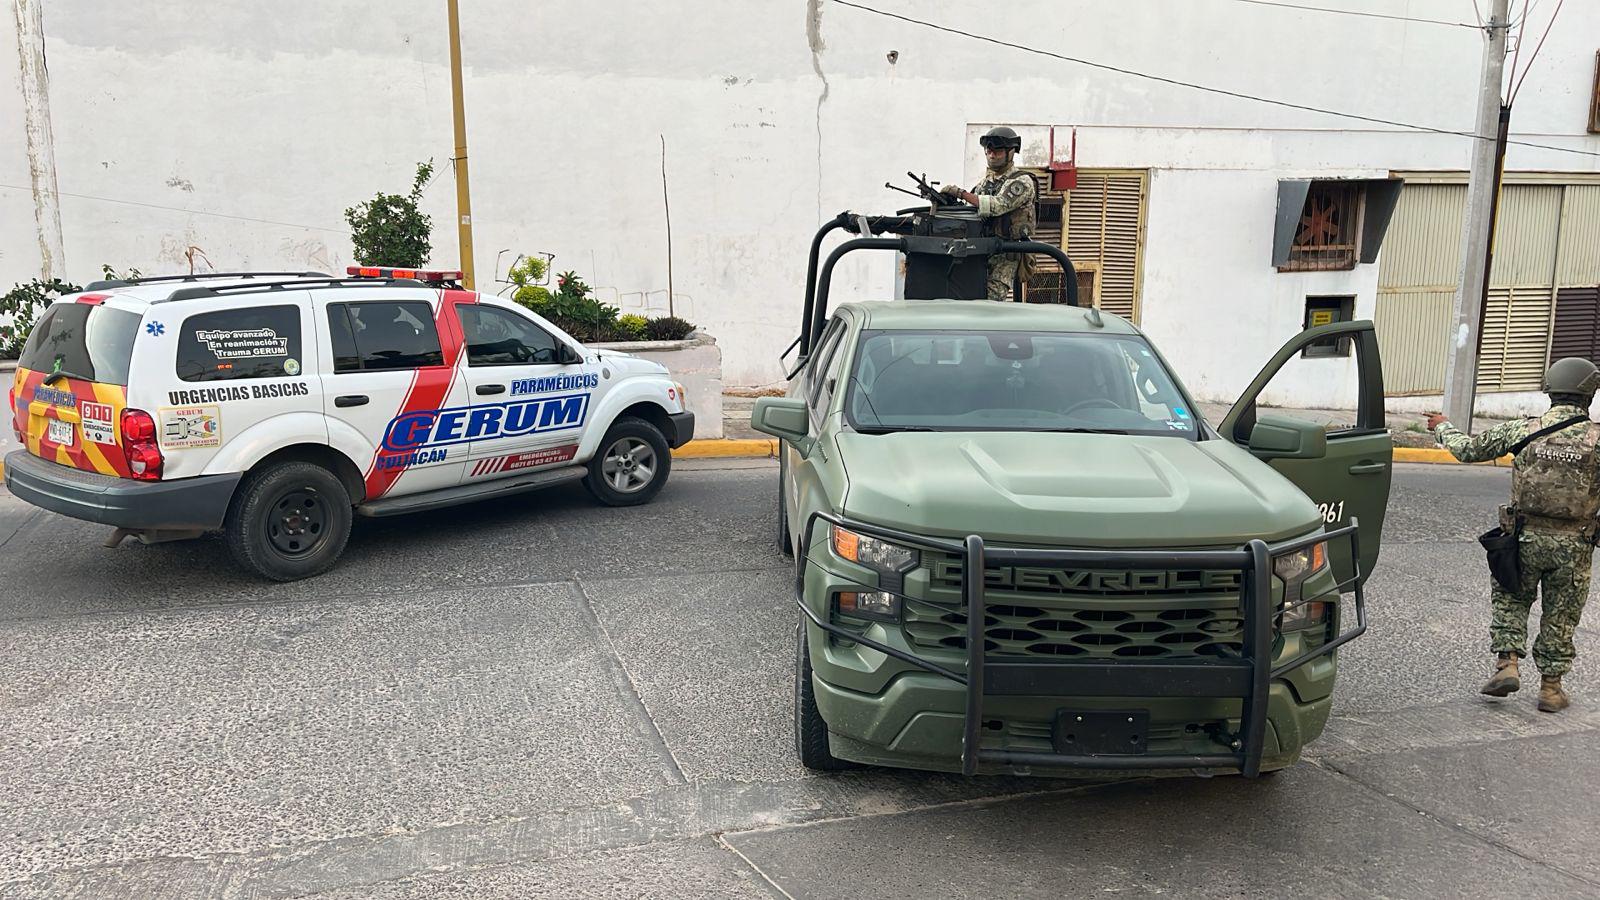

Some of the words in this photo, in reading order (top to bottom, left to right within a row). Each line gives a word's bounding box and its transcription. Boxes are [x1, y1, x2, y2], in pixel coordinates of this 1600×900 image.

[199, 331, 230, 340] Equipo
[233, 330, 274, 338] avanzado
[224, 339, 278, 348] reanimación
[280, 340, 285, 348] y
[217, 349, 251, 357] Trauma
[253, 347, 285, 355] GERUM
[511, 373, 598, 396] PARAMÉDICOS
[168, 386, 250, 405] URGENCIAS
[252, 382, 309, 402] BASICAS
[84, 405, 112, 421] 911
[84, 423, 113, 433] EMERGENCIAS
[388, 398, 585, 447] GERUM
[376, 448, 448, 470] CULIACÁN
[519, 449, 560, 461] EMERGENCIAS
[1535, 447, 1582, 460] EJERCITO
